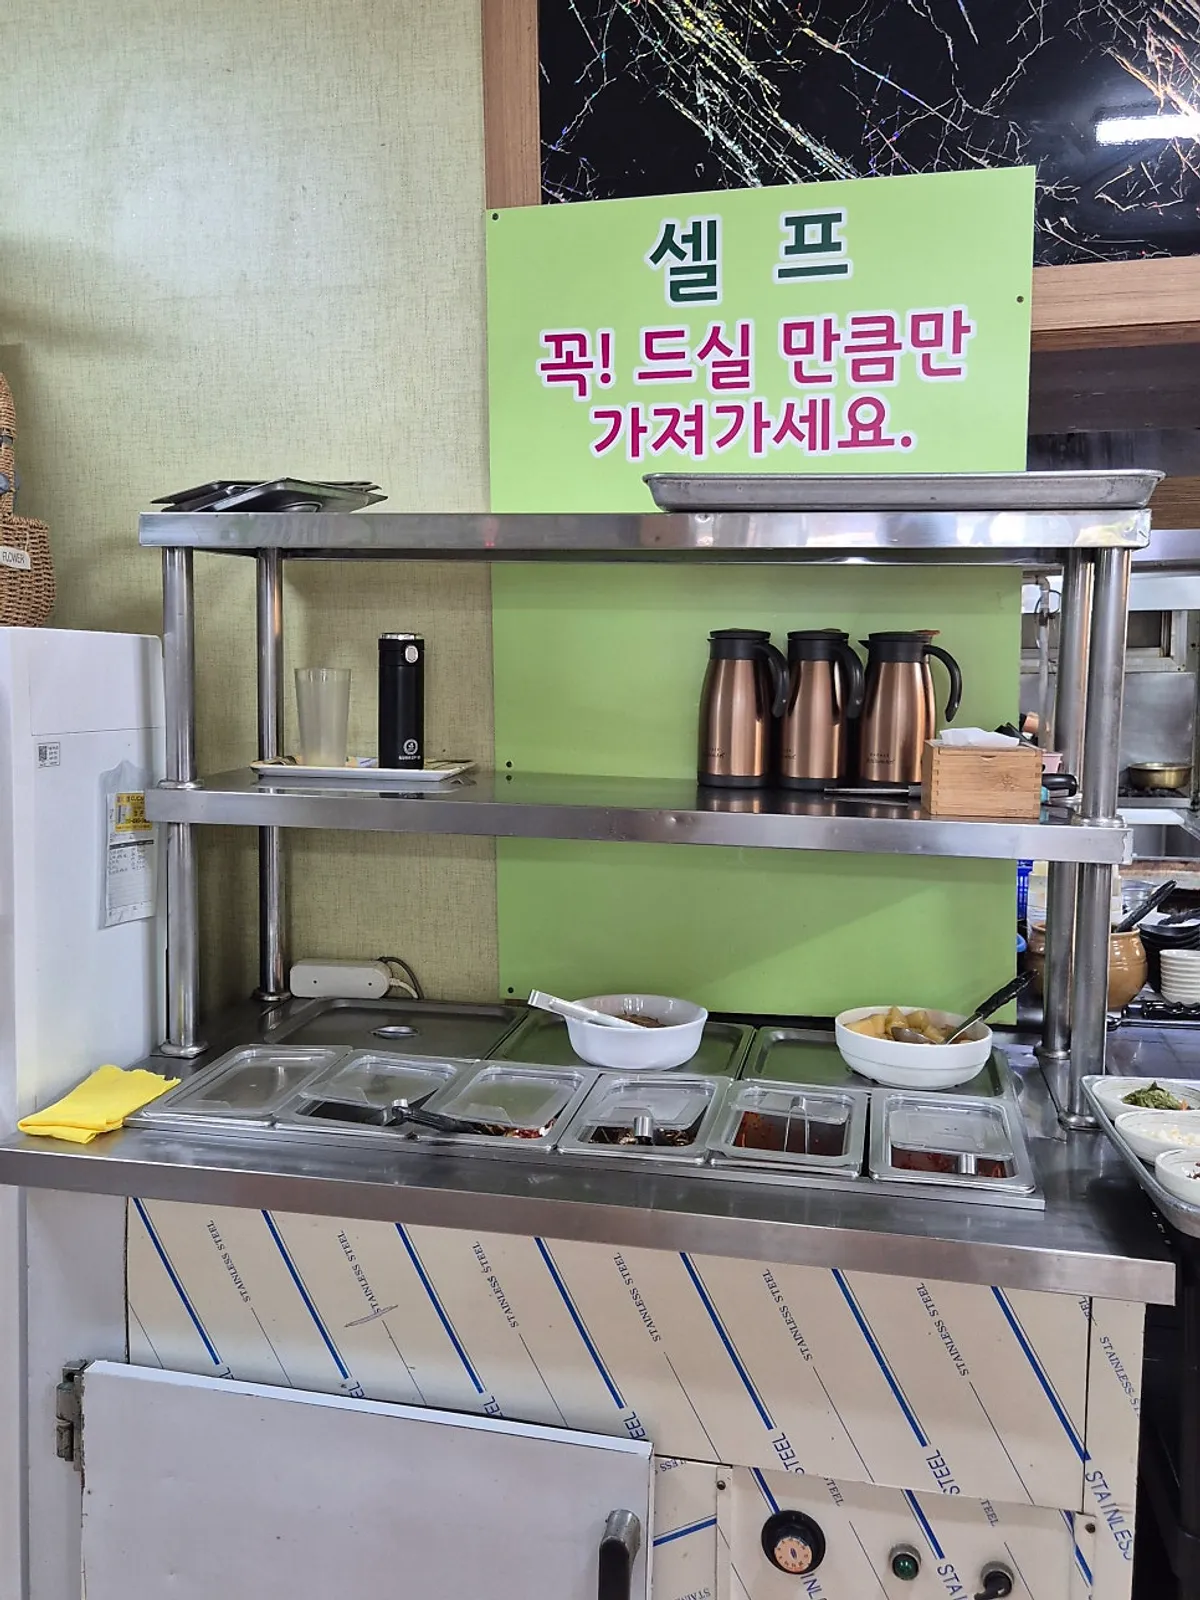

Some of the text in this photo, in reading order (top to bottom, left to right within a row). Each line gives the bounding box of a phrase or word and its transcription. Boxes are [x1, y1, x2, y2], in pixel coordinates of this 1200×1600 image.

[649, 212, 848, 302] 셀 프
[541, 310, 971, 397] 꼭! 드실 만큼만
[593, 396, 912, 458] 가져가세요.
[3, 551, 24, 563] FLOWER
[207, 1220, 251, 1303] STAINLESS STEEL
[337, 1230, 380, 1315] STAINLESS STEEL
[472, 1241, 519, 1328] STAINLESS STEEL
[613, 1252, 661, 1342] STAINLESS STEEL
[762, 1268, 813, 1361] STAINLESS STEEL
[916, 1282, 969, 1376] STAINLESS STEEL
[1099, 1336, 1135, 1399] STAINLESS
[823, 1477, 844, 1507] TEEL
